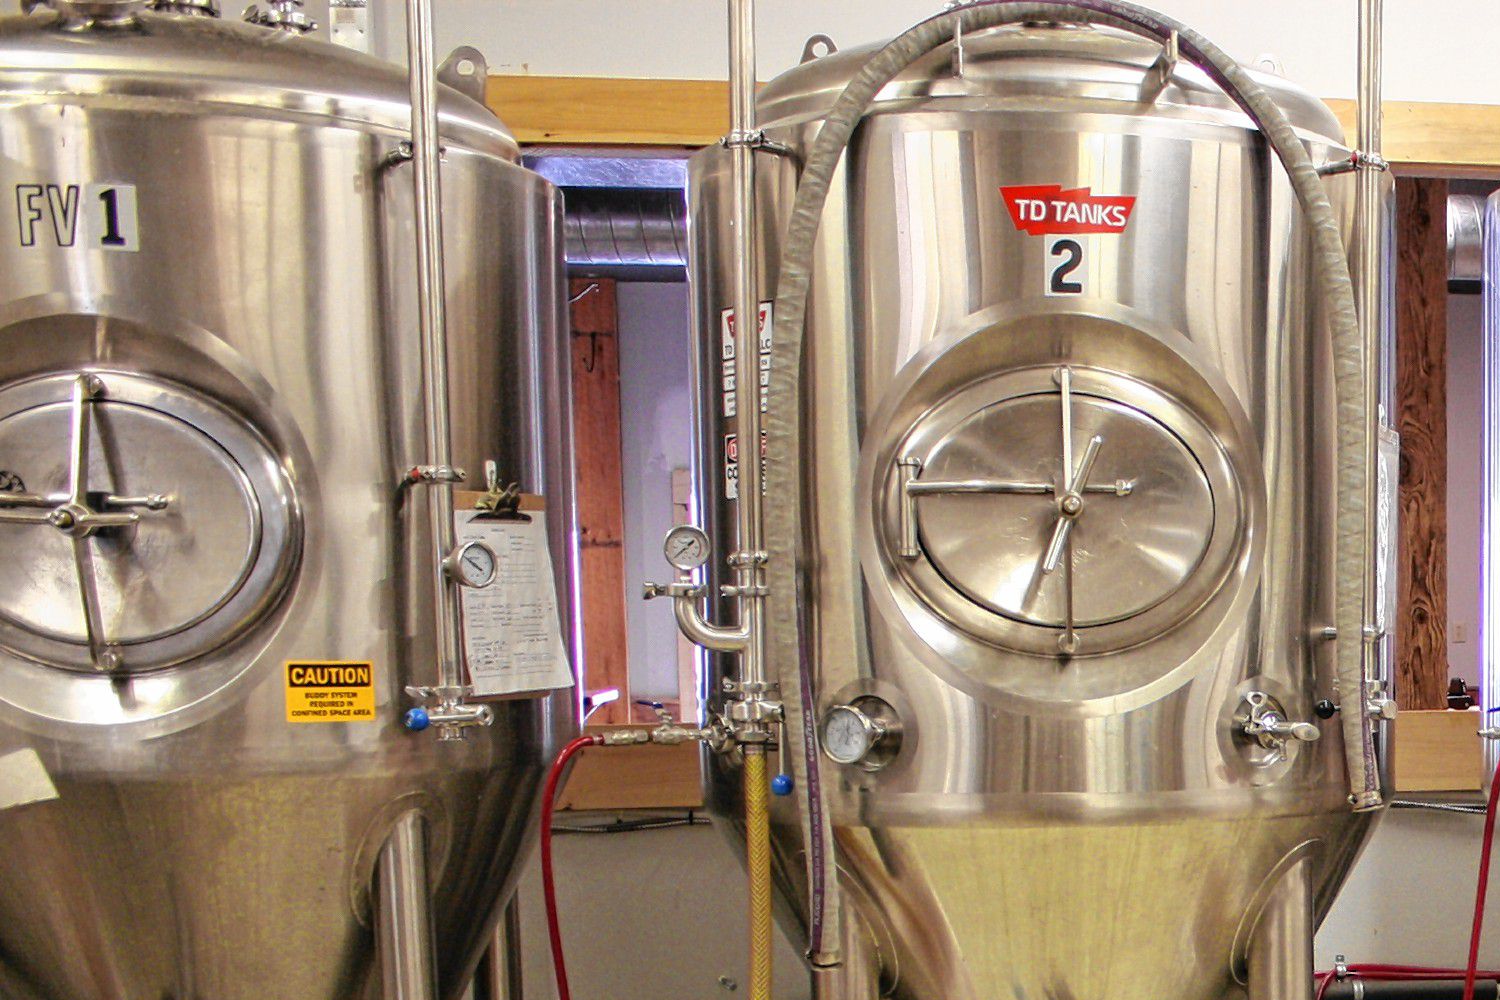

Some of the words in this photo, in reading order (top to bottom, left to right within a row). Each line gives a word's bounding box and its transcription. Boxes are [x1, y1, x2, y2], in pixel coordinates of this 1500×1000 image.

[16, 184, 79, 246] FV
[99, 188, 126, 246] 1
[1015, 199, 1047, 222] TD
[1051, 200, 1126, 227] TANKS
[1051, 239, 1083, 293] 2
[291, 667, 369, 685] CAUTION
[309, 700, 345, 708] REQUIRED
[330, 691, 358, 699] SYSTEM
[291, 709, 328, 717] CONFINED
[329, 708, 351, 716] SPACE
[353, 708, 372, 716] AREA
